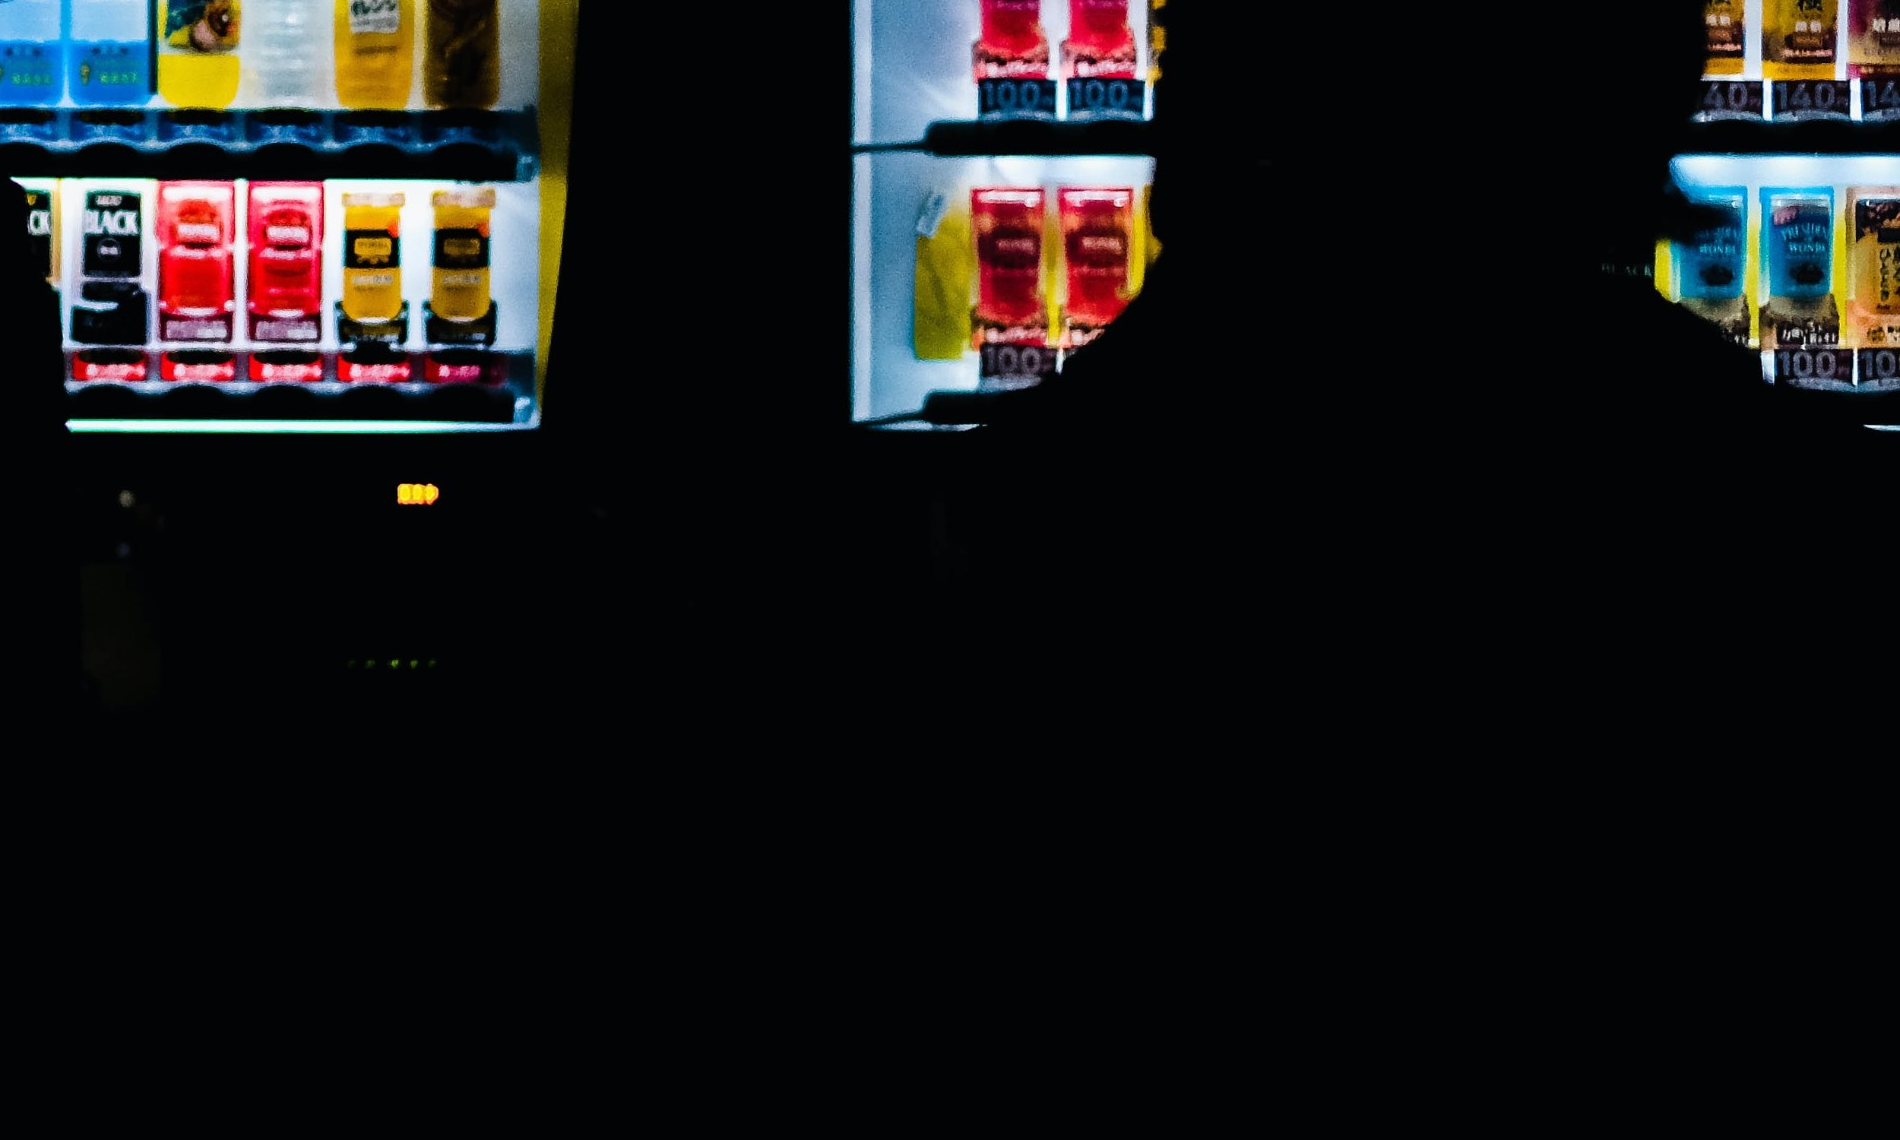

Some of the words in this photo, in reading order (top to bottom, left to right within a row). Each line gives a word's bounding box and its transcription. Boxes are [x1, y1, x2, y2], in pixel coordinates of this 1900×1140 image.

[982, 80, 1041, 108] 100
[1070, 80, 1129, 108] 100
[1703, 81, 1748, 109] 40
[1774, 81, 1836, 110] 140
[1864, 80, 1900, 110] 14
[983, 346, 1042, 374] 100
[1777, 350, 1837, 379] 100
[1861, 350, 1900, 380] 10
